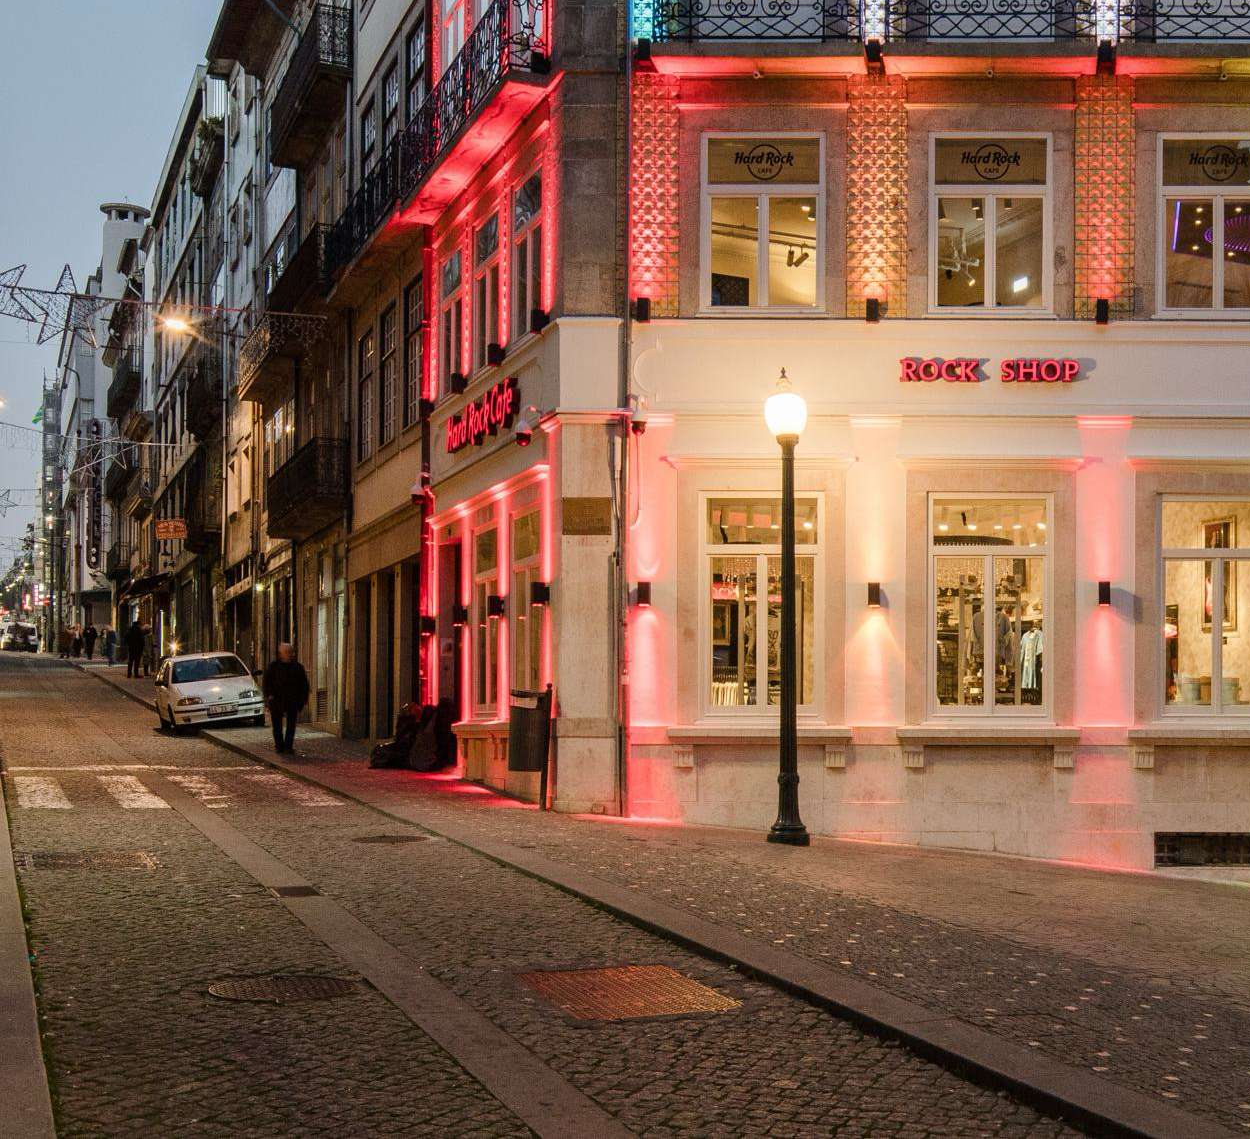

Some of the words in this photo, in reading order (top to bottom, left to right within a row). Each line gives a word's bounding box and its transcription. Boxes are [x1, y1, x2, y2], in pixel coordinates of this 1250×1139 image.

[735, 152, 764, 164] Hard
[766, 152, 794, 166] Rock
[961, 152, 991, 164] Hard
[992, 152, 1020, 166] Rock
[1188, 152, 1219, 165] Hard
[899, 359, 980, 382] ROCK
[1001, 359, 1080, 382] SHOP
[446, 405, 468, 453] Hard
[468, 391, 490, 446] Rock
[490, 376, 513, 429] Cafe
